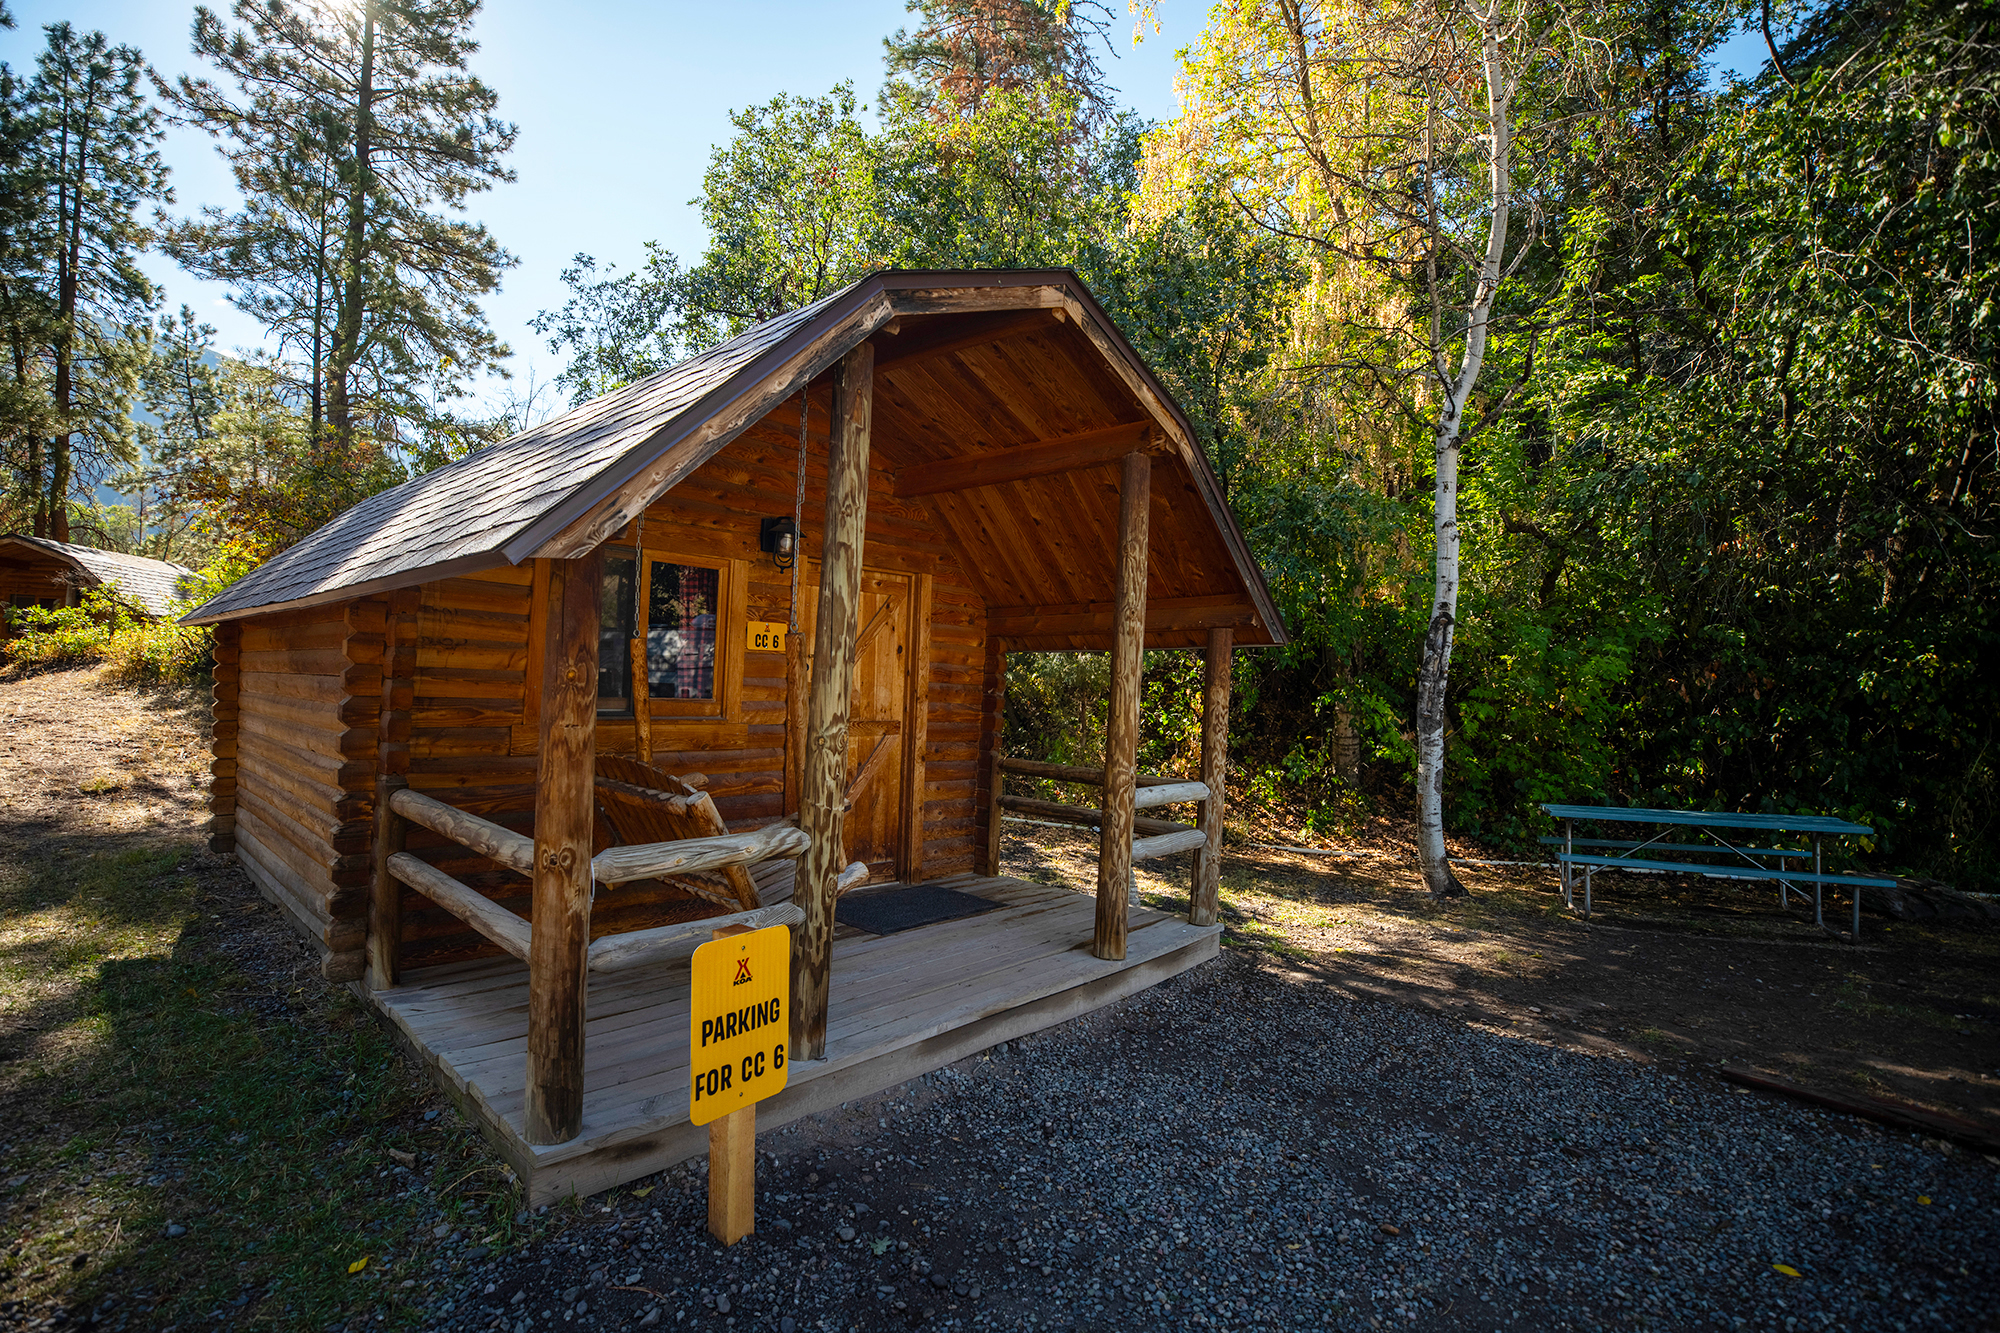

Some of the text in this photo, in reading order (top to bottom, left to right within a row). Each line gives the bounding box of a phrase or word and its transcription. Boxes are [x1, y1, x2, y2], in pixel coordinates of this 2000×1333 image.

[755, 634, 779, 648] CC 6
[733, 976, 752, 987] KOA
[702, 997, 780, 1048] PARKING
[695, 1044, 784, 1101] FOR CC 6
